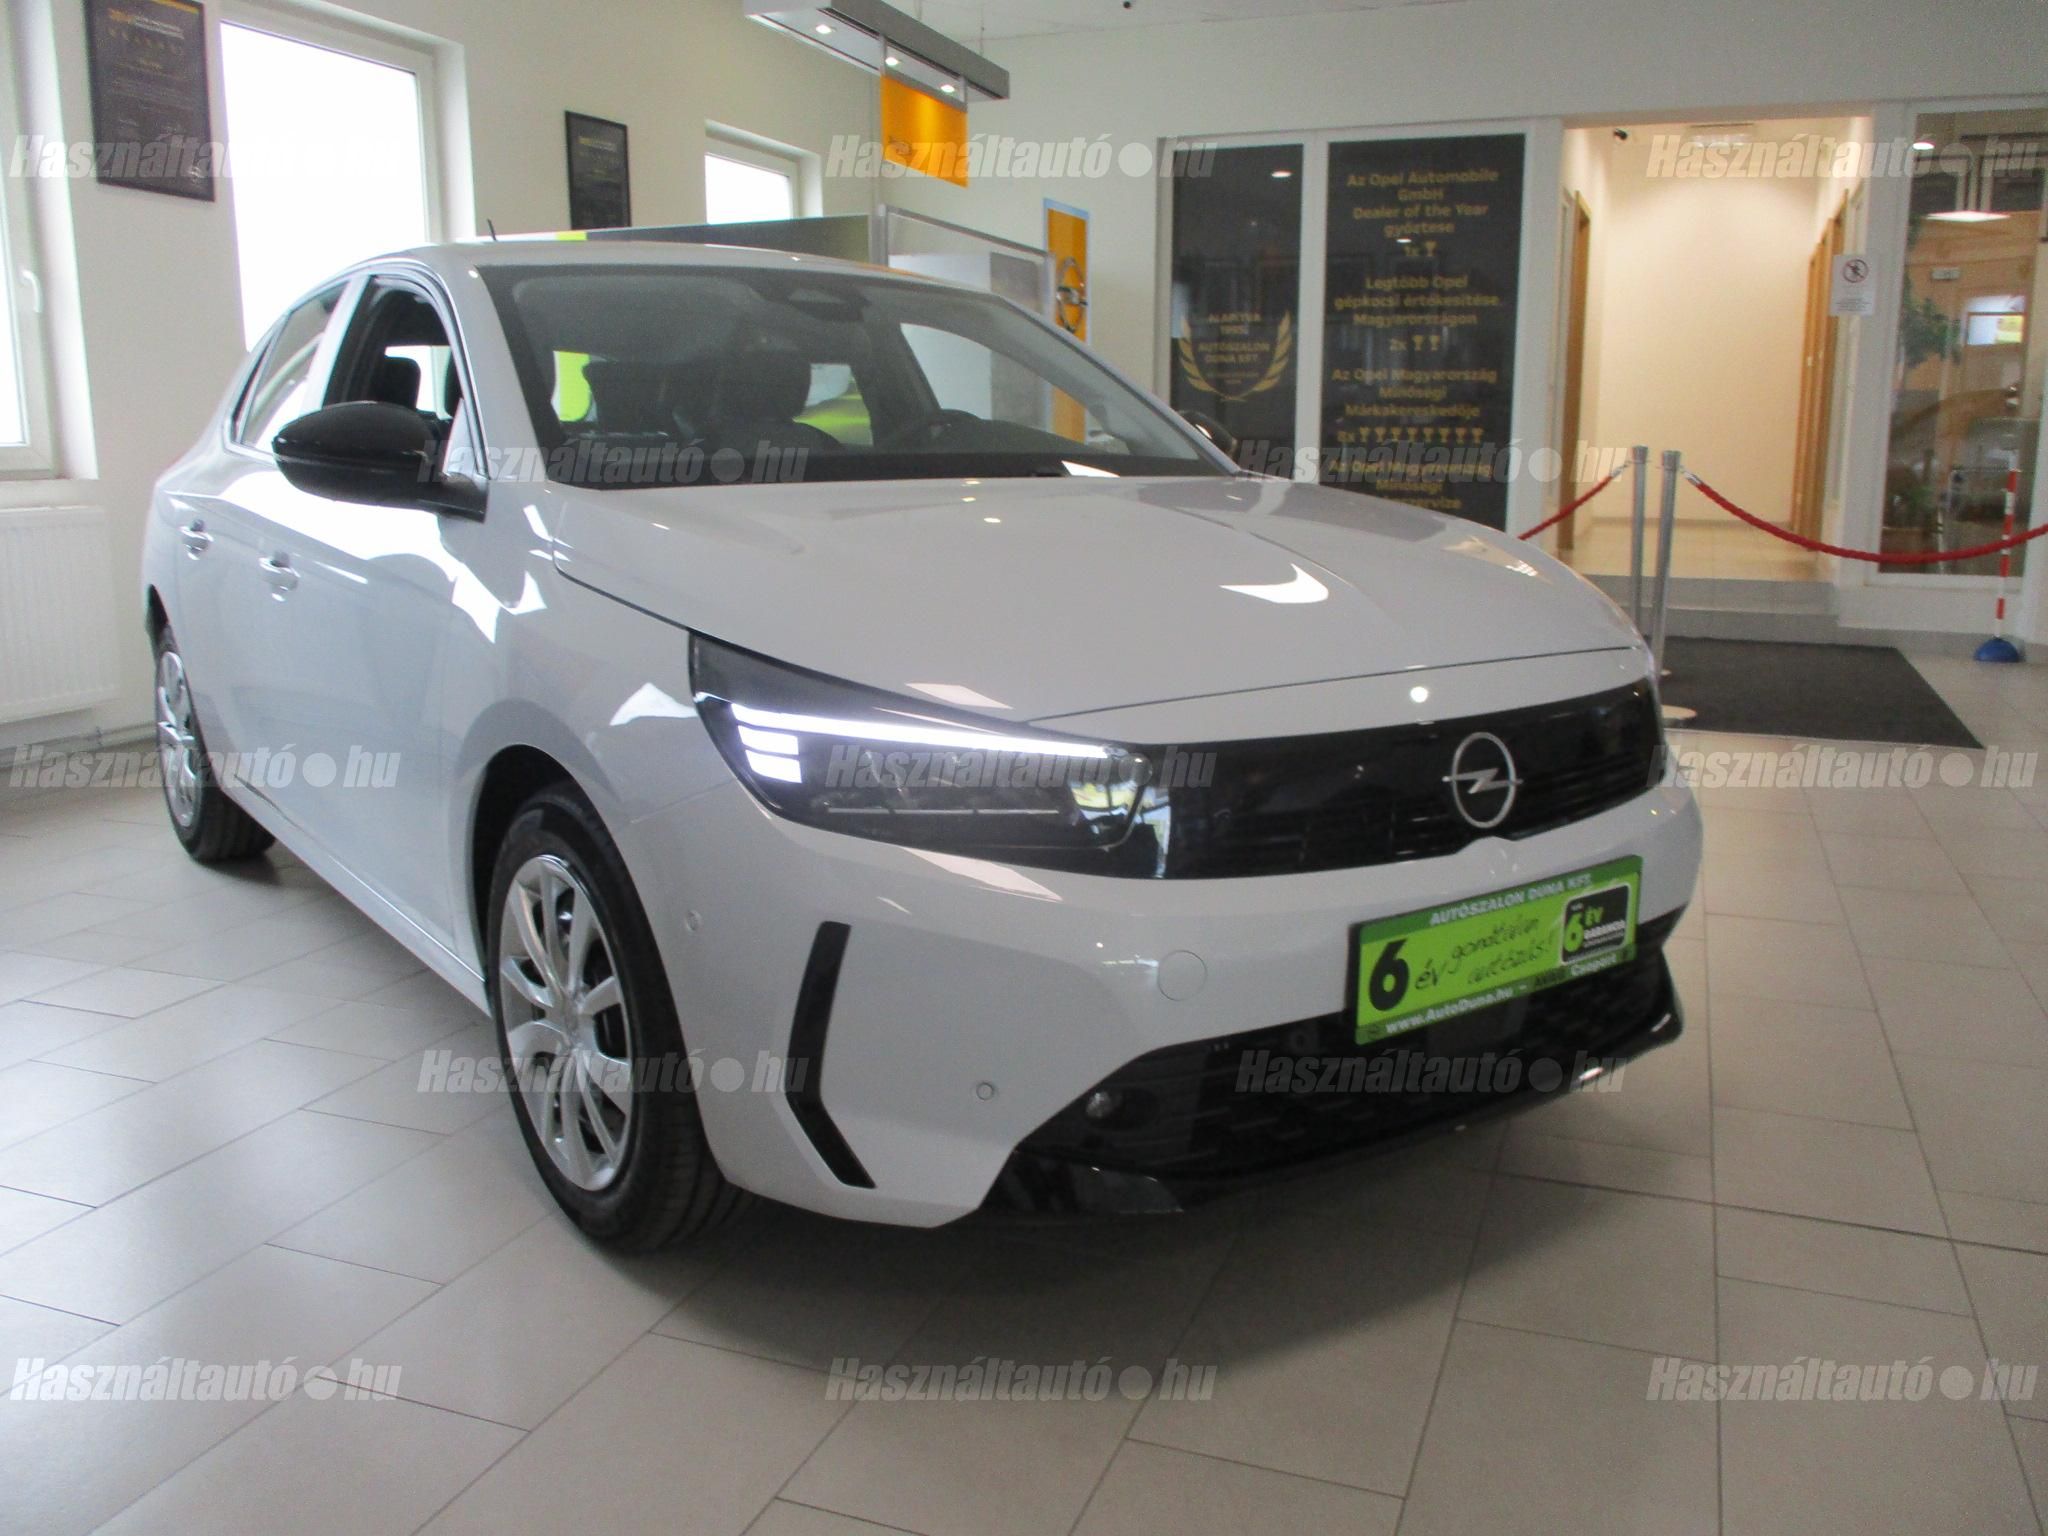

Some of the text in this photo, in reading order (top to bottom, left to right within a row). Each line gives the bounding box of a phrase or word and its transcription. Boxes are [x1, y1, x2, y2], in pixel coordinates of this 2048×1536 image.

[1370, 172, 1404, 188] Opel
[1407, 167, 1500, 185] Automobile
[1397, 188, 1445, 201] GmbH
[1353, 202, 1489, 220] Dealer of the Year
[1432, 274, 1469, 291] Opel
[1429, 890, 1526, 926] AUTÓSZALON
[1528, 880, 1564, 900] DUNA
[1564, 911, 1584, 953] 6
[1369, 938, 1410, 1012] 6
[1414, 958, 1447, 991] év
[1385, 985, 1514, 1034] www.AutoDuna.hu
